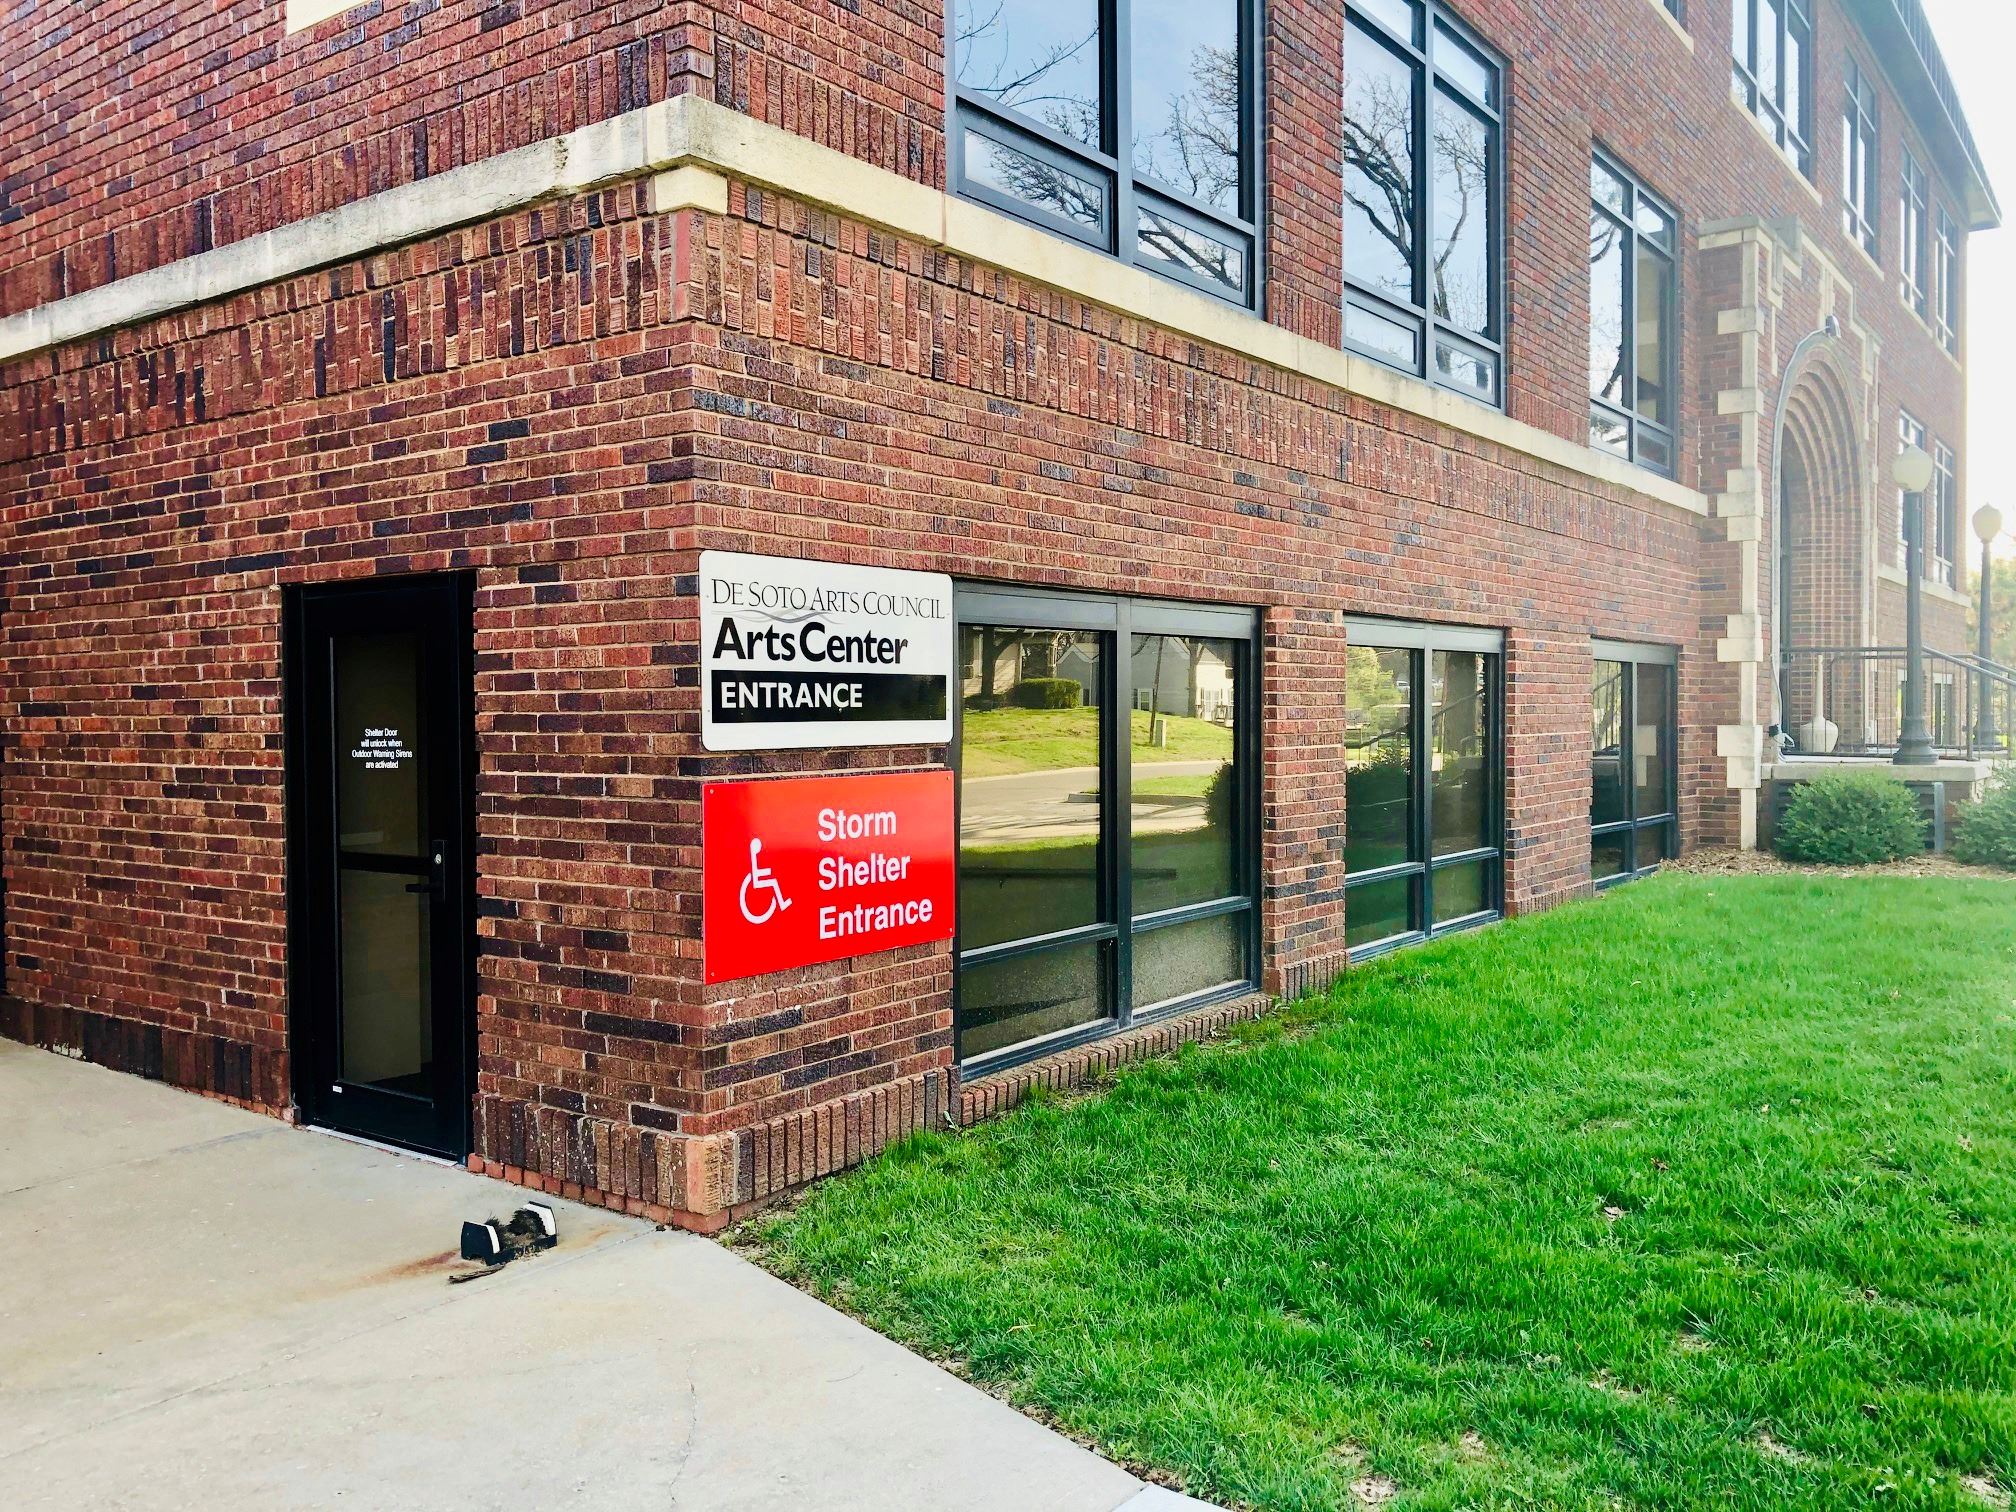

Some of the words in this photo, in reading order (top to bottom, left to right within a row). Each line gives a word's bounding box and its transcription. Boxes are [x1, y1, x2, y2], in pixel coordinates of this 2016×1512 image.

[711, 578, 744, 606] DE
[748, 581, 807, 610] SOTO
[809, 586, 860, 614] ARTS
[863, 591, 945, 620] COUNCIL
[720, 681, 863, 709] ENTRANCE
[360, 738, 370, 748] will
[370, 738, 387, 748] unlock
[388, 738, 403, 747] when
[364, 728, 383, 737] Shelter
[384, 727, 398, 737] Door
[351, 749, 372, 758] Outdoor
[373, 749, 395, 760] Warning
[395, 749, 413, 758] Sirens
[375, 760, 399, 769] activated
[817, 808, 897, 842] Storm
[818, 852, 911, 891] Shelter
[819, 898, 933, 940] Entrance
